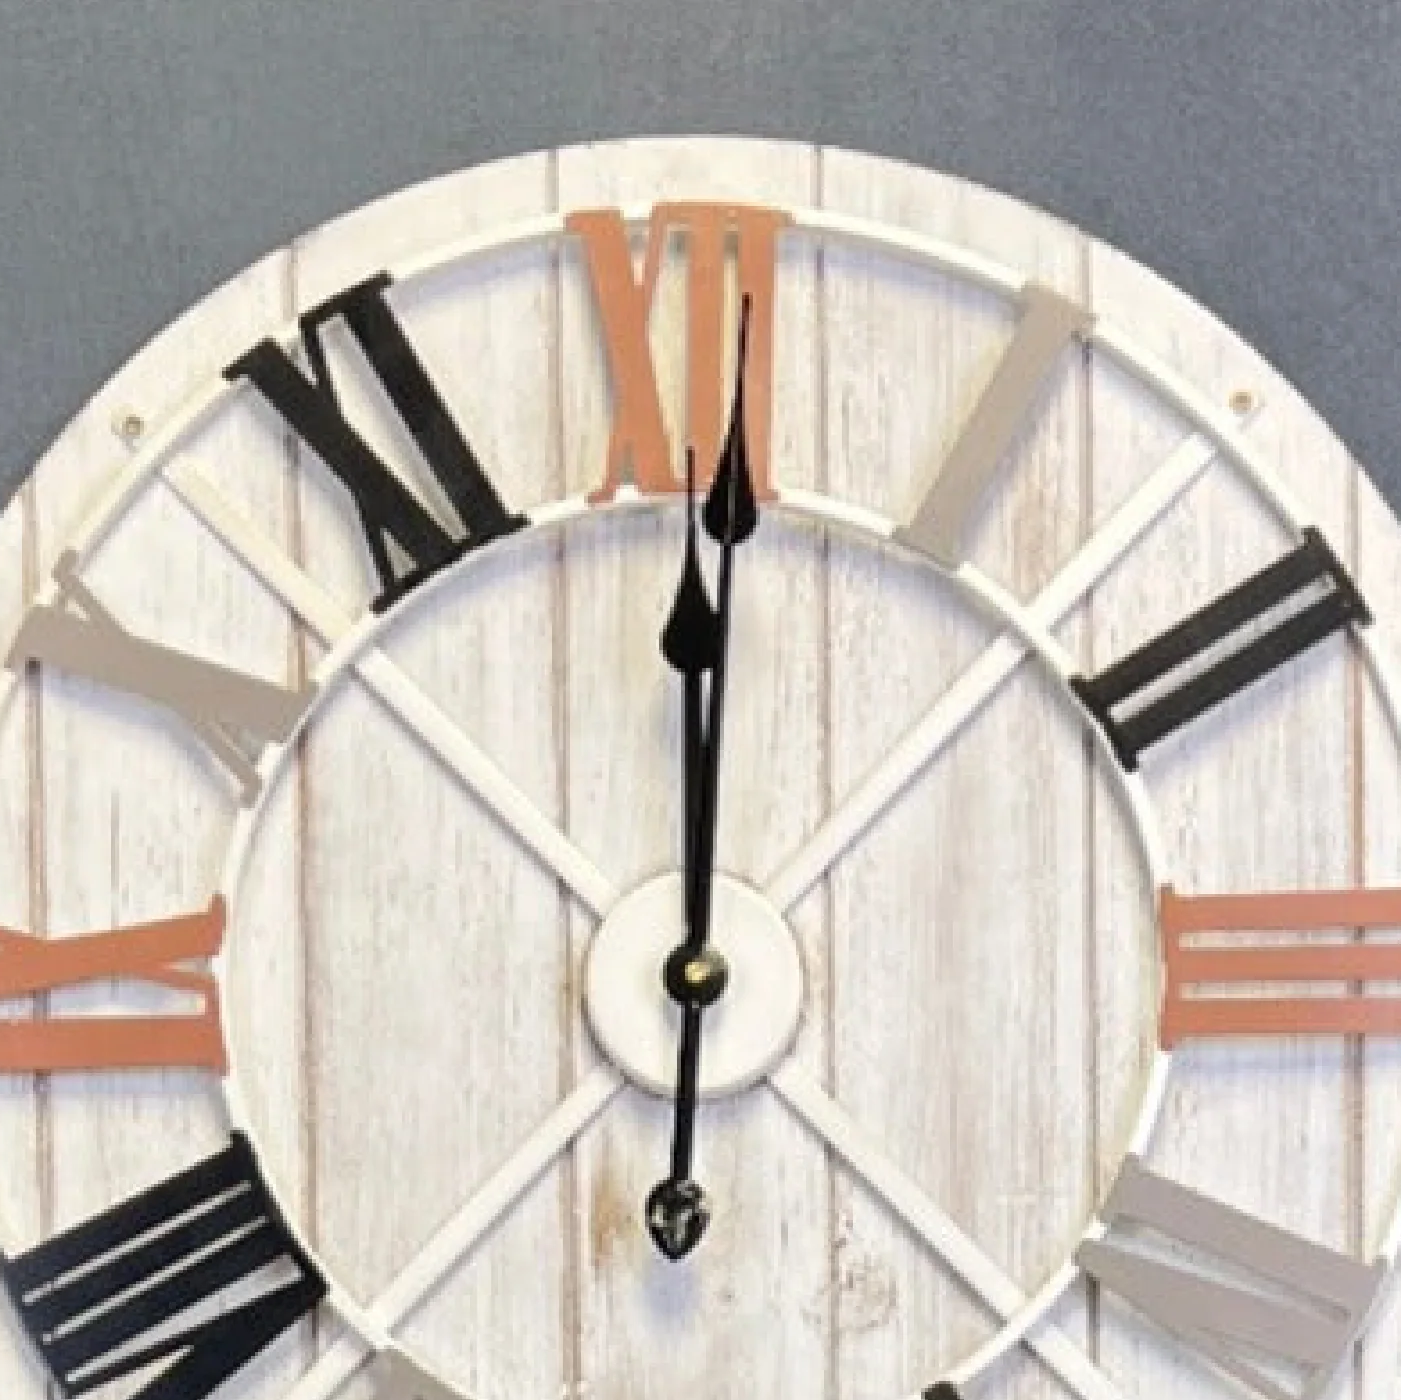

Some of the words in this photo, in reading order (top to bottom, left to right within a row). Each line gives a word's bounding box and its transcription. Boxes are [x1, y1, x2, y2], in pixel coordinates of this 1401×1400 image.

[223, 270, 531, 615] XI
[563, 203, 797, 502] XII
[890, 281, 1097, 568] I
[3, 549, 320, 807] X
[1068, 526, 1372, 773] II
